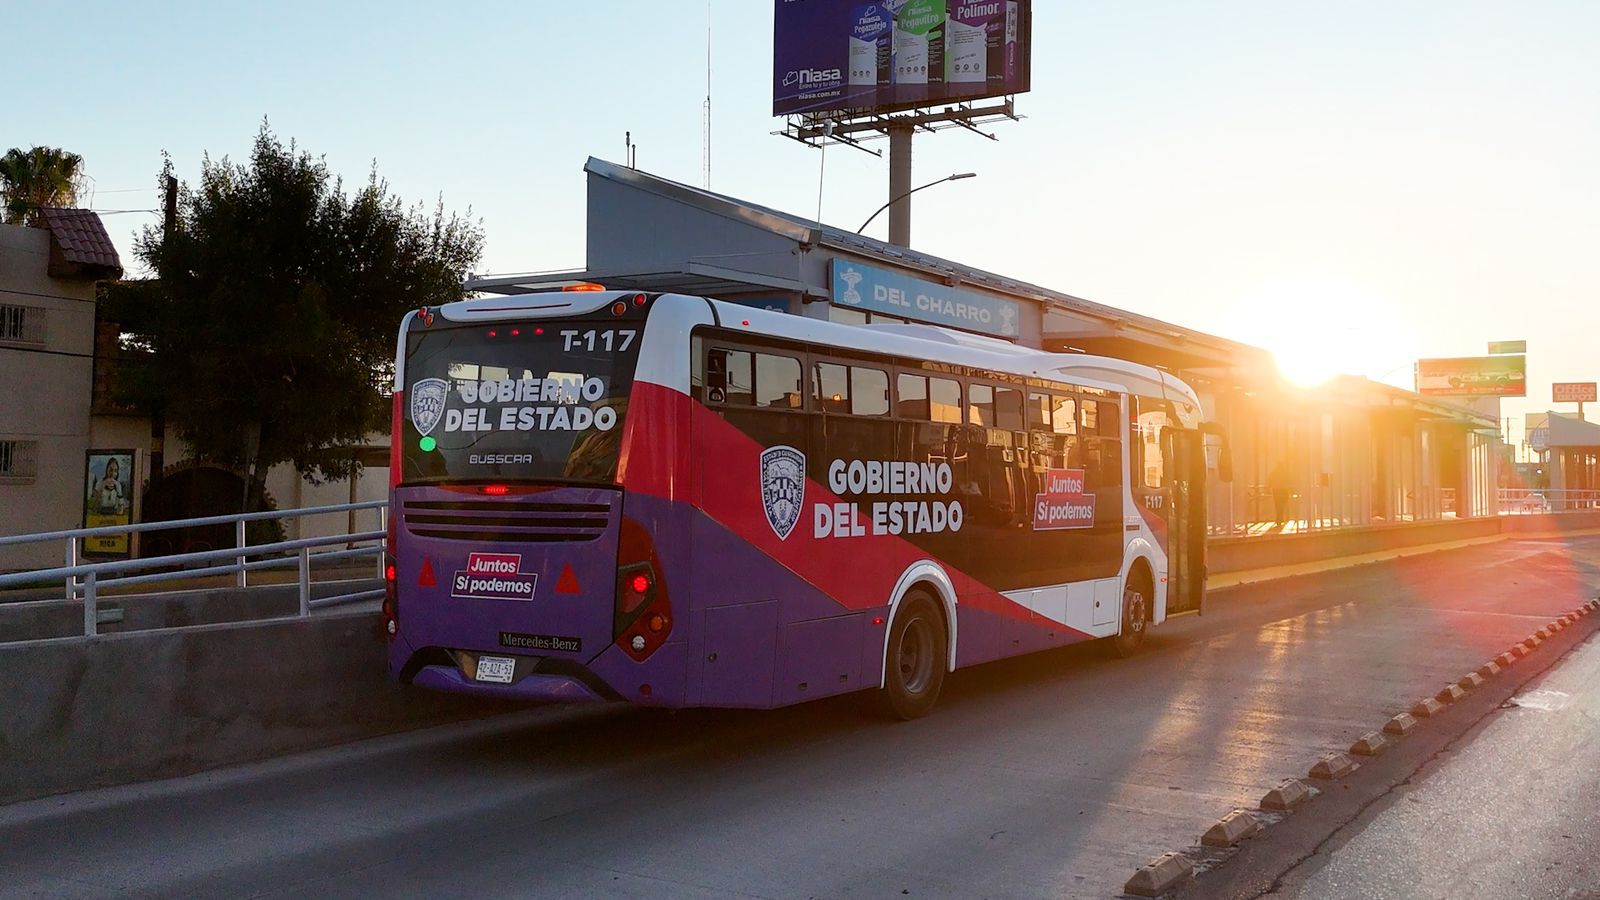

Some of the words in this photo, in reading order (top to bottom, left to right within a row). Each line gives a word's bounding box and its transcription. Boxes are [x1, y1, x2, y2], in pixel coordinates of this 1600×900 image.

[957, 2, 999, 20] Polimor
[799, 68, 841, 84] niasa
[874, 285, 911, 307] DEL
[916, 294, 992, 323] CHARRO
[560, 329, 637, 352] T-117
[461, 377, 605, 404] GOBIERNO
[444, 407, 492, 432] DEL
[499, 406, 617, 432] ESTADO
[469, 454, 533, 464] BUSSCAR
[828, 458, 953, 495] GOBIERNO
[1049, 475, 1082, 494] Juntos
[1144, 495, 1163, 509] T-117
[814, 502, 866, 539] DEL
[872, 500, 963, 536] ESTADO
[1049, 503, 1093, 524] podemos
[470, 557, 516, 573] Juntos
[456, 575, 469, 590] Sí
[470, 577, 532, 594] podemos
[502, 633, 578, 651] Mercedes-Benz
